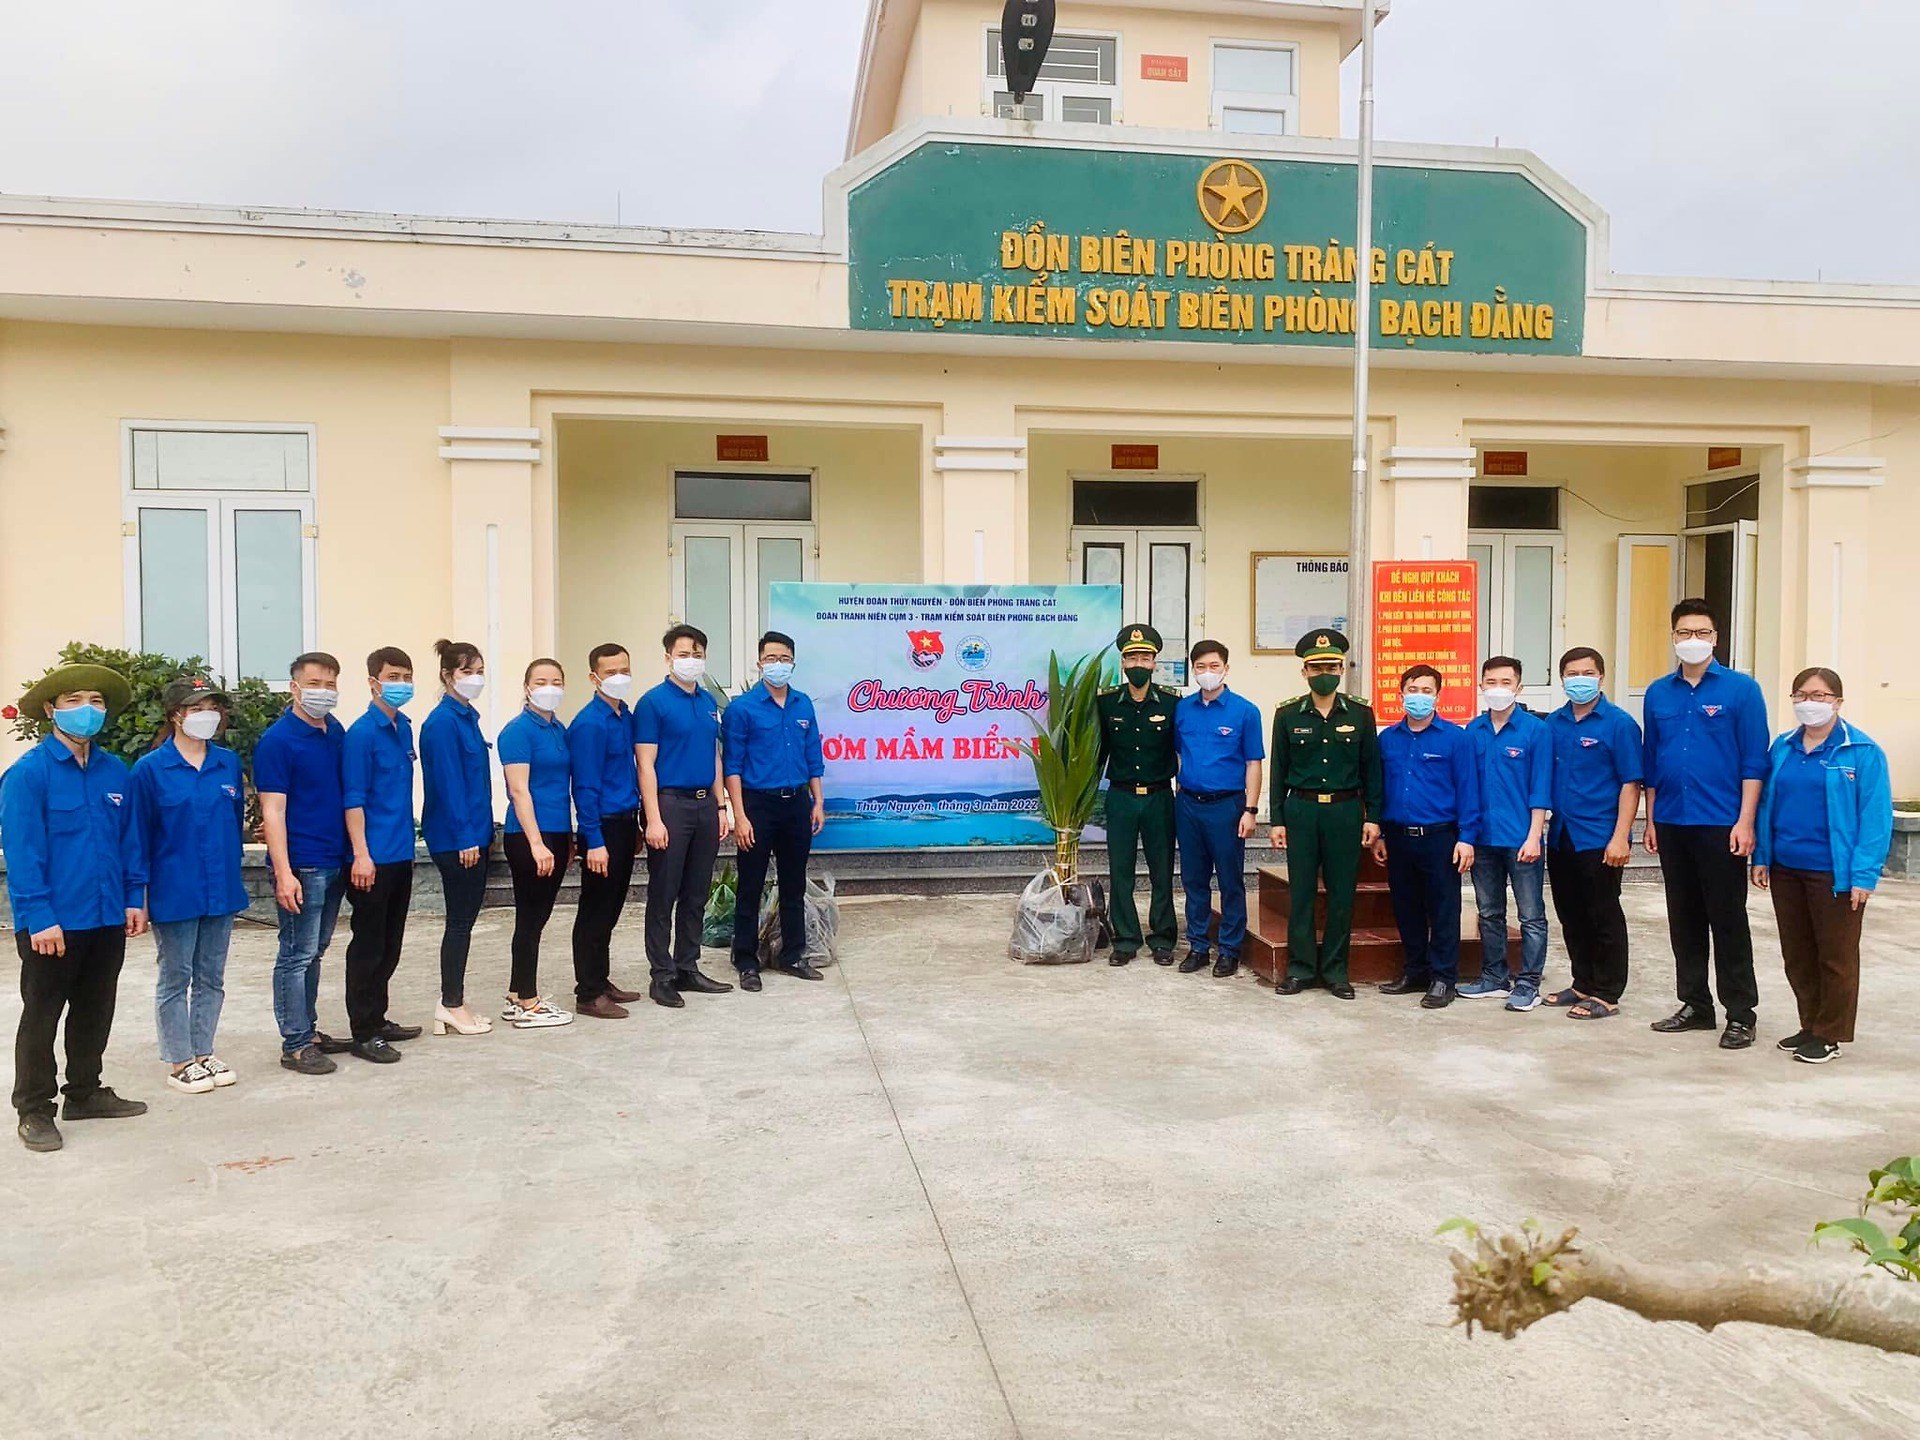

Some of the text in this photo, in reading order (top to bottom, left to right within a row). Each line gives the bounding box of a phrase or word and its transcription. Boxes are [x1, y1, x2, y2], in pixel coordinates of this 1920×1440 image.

[1001, 220, 1454, 286] ĐỒN BIÊN PHÒNG TRÀNG CÁT
[888, 271, 1555, 345] TRẠM KIỂM SOÁT BIÊN PHÒN BẠCH ĐẰNG
[908, 612, 914, 621] 3
[847, 678, 1047, 724] Chương Trình
[819, 734, 867, 760] ƠM
[875, 726, 944, 760] MẦM
[973, 800, 980, 811] 3
[1010, 799, 1038, 811] 2022
